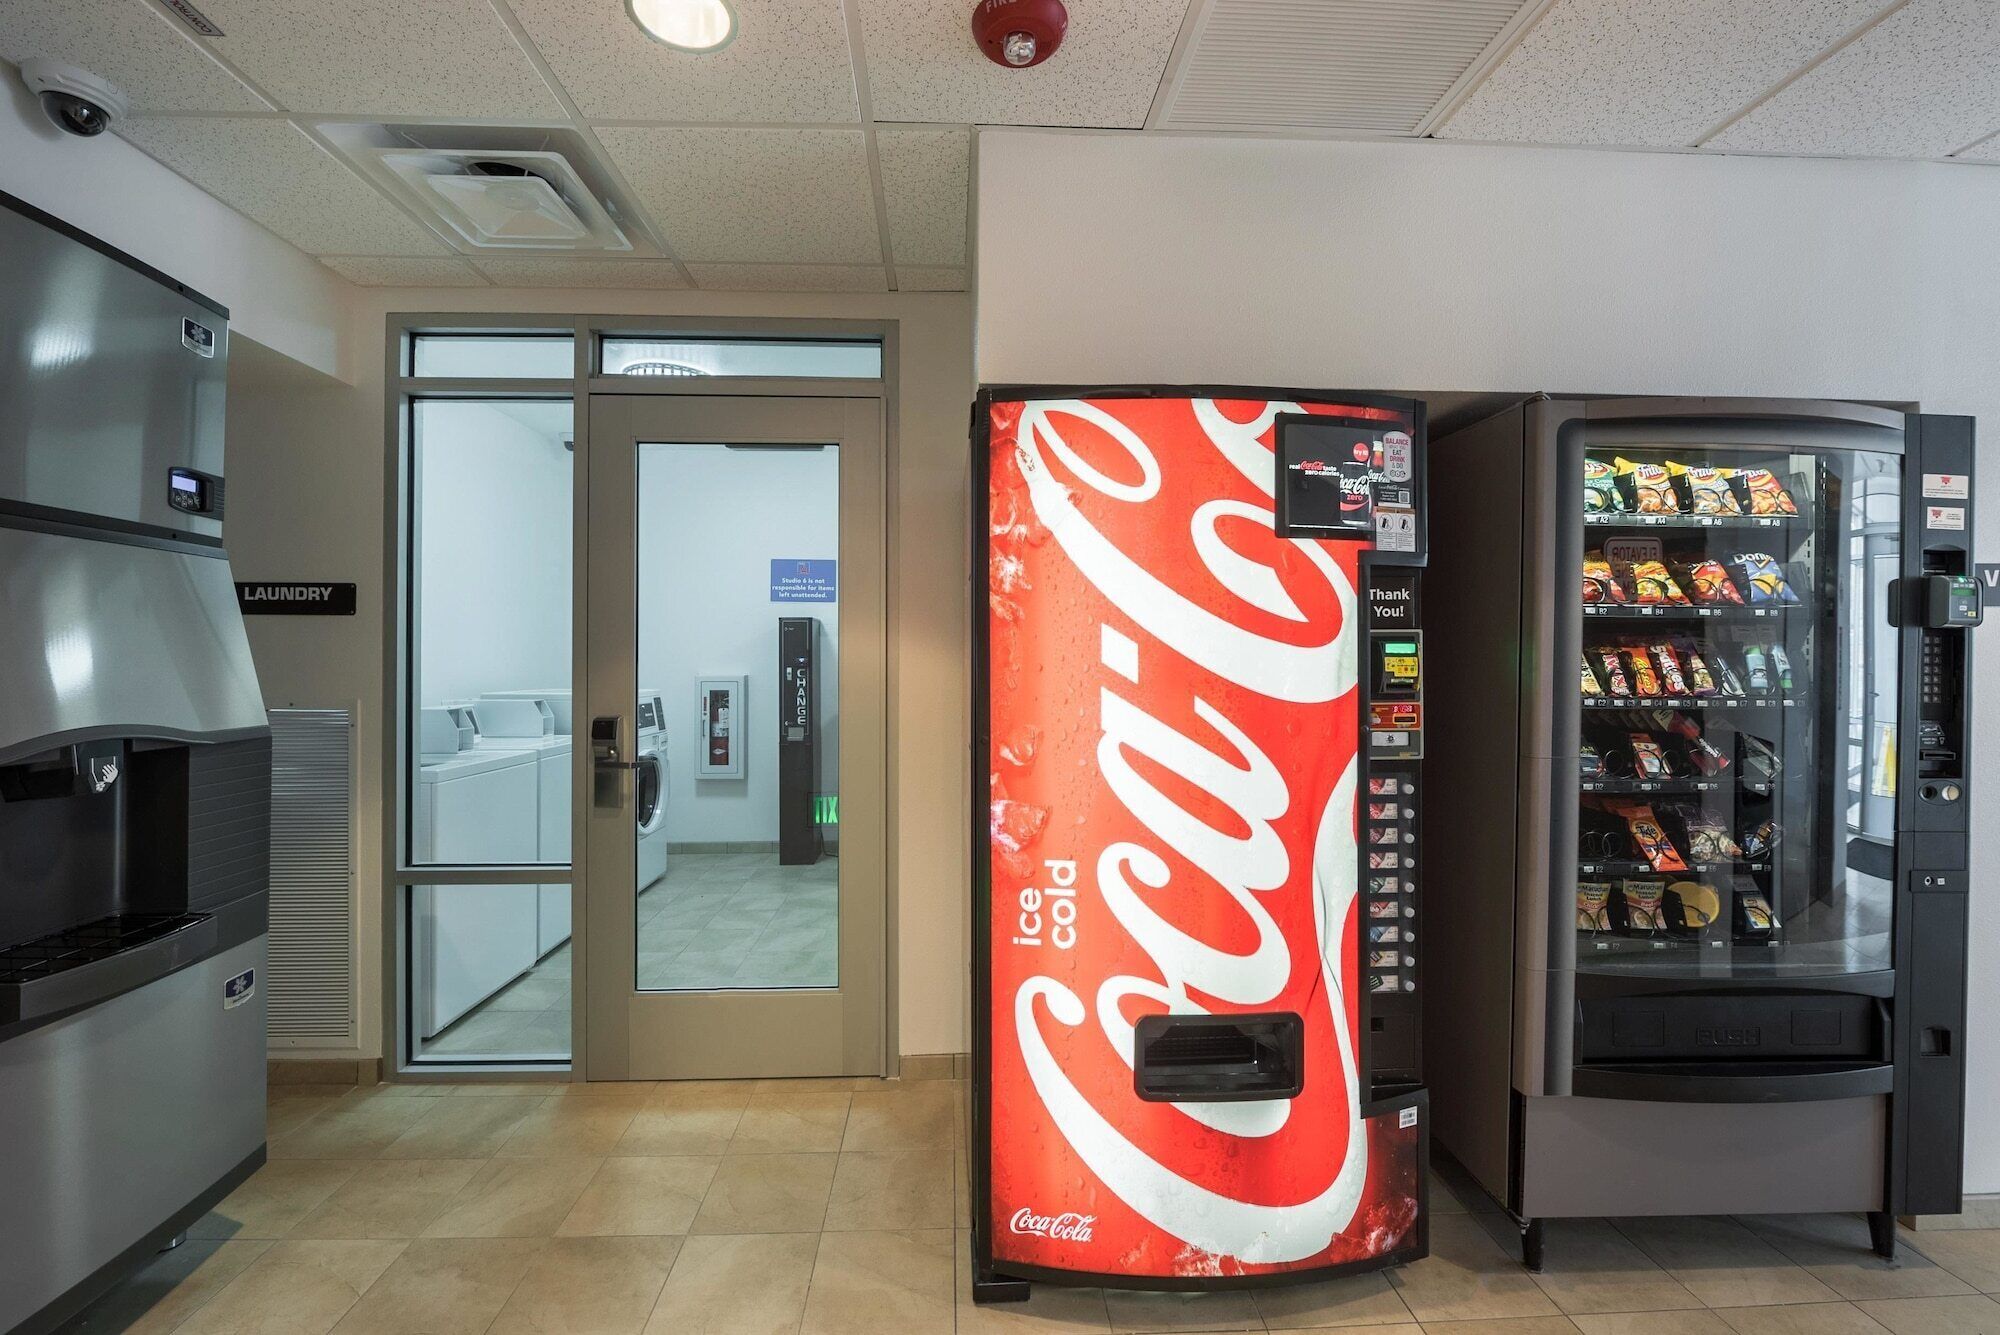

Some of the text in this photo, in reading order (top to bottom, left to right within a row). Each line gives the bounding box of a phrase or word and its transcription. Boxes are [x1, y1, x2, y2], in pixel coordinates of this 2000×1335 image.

[1389, 455, 1406, 463] DRINK
[1346, 494, 1364, 502] zero
[1599, 516, 1609, 524] A2
[1657, 517, 1666, 525] A4
[244, 586, 333, 601] LAUNDRY
[1369, 588, 1410, 601] Thank
[1373, 605, 1404, 618] You!
[1598, 607, 1608, 615] B2
[796, 668, 806, 725] CHANGE
[1598, 699, 1607, 707] C2
[1044, 859, 1077, 950] cold
[1012, 887, 1042, 946] ice
[1009, 1207, 1098, 1243] Coca-Cola
